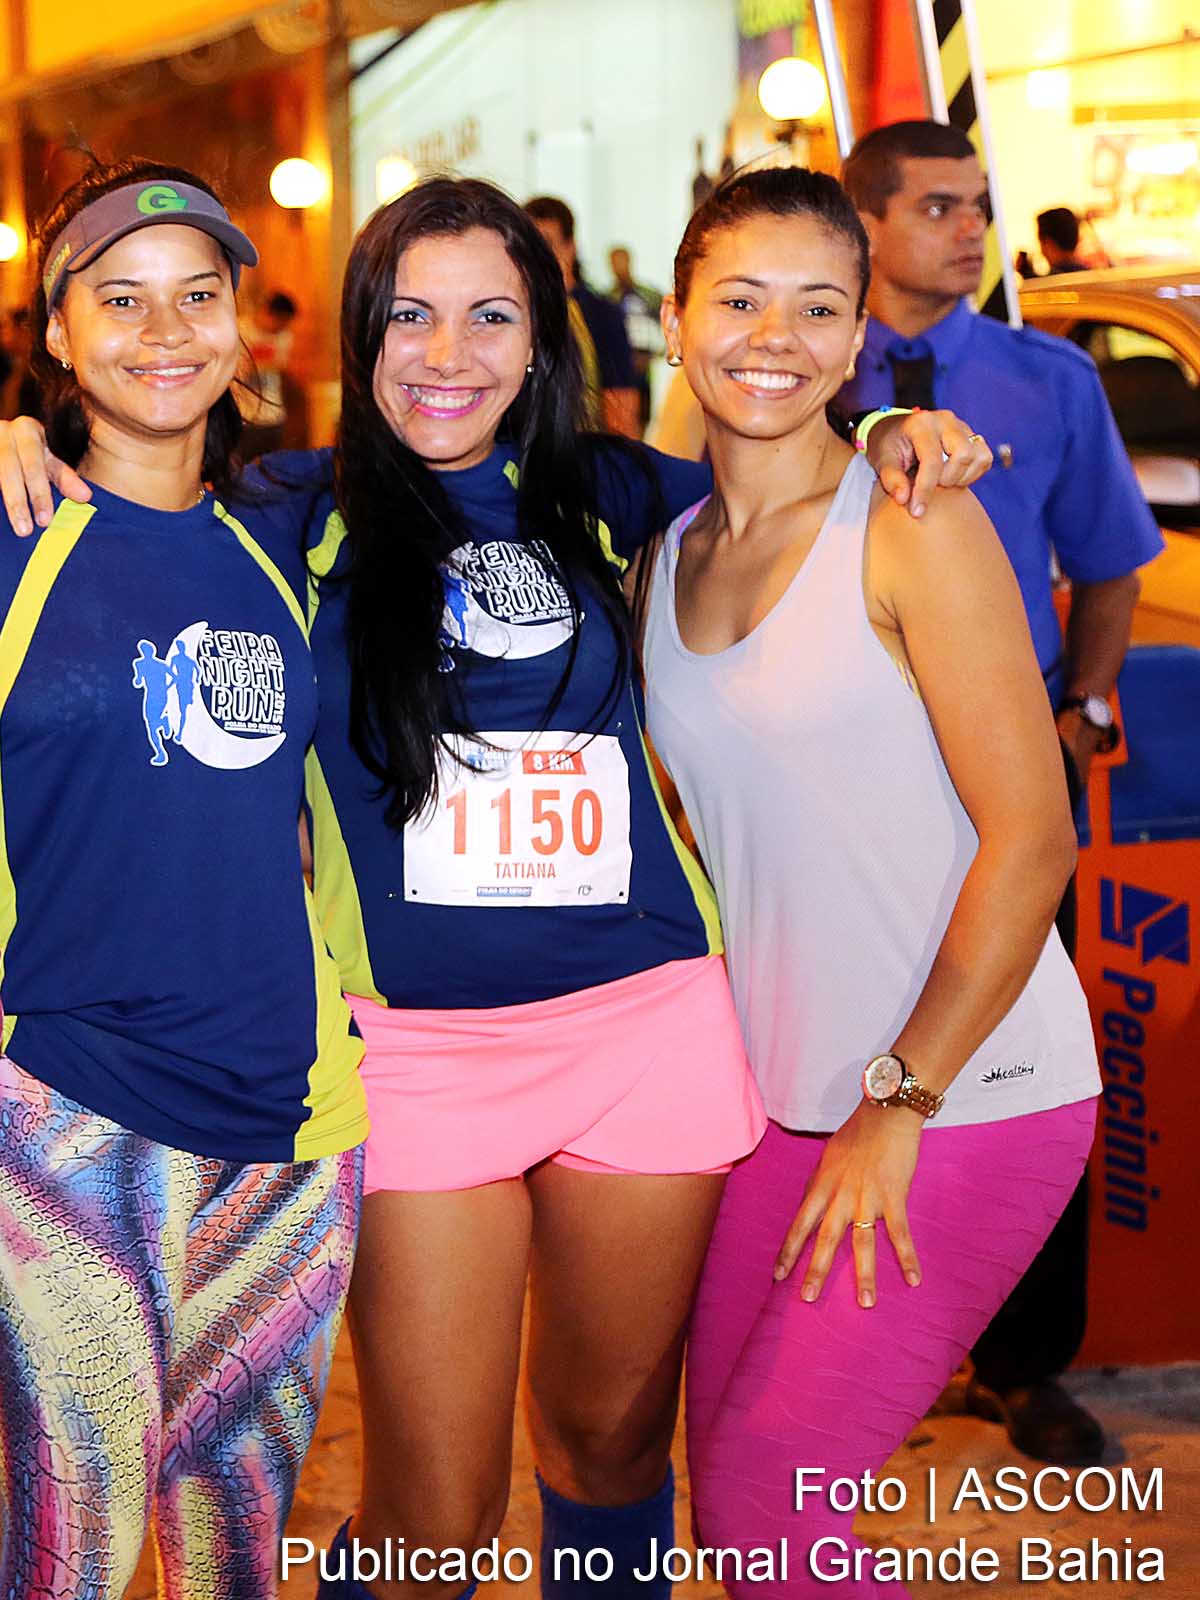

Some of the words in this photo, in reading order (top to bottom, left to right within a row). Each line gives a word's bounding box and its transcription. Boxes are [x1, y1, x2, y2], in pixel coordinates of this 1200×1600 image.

[486, 582, 561, 617] RUN
[200, 629, 283, 661] FEIRA
[200, 656, 285, 692] NIGHT
[211, 686, 275, 723] RUN
[532, 752, 544, 771] 8
[548, 752, 575, 771] KM
[446, 788, 603, 856] 1150
[494, 862, 557, 879] TATIANA
[1102, 967, 1161, 1232] Peccinin
